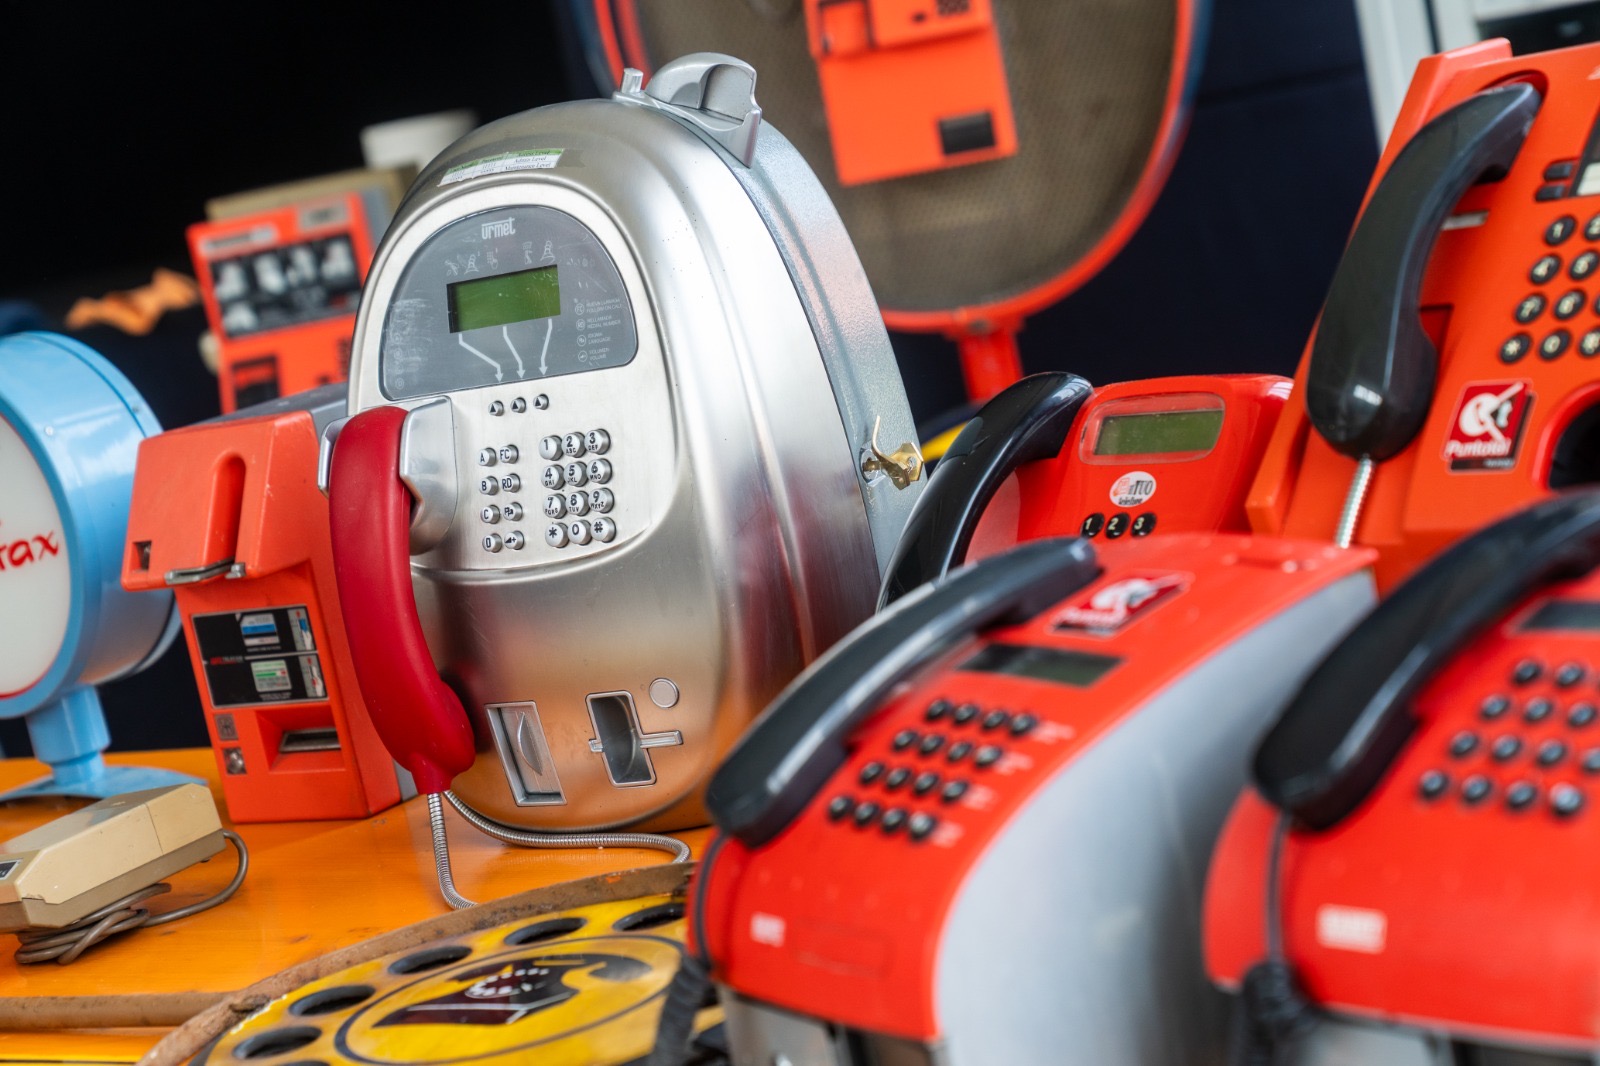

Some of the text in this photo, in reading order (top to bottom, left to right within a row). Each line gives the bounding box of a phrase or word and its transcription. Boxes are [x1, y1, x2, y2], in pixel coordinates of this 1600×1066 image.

[481, 217, 516, 240] urmet
[544, 432, 596, 450] 1 2 3
[480, 450, 510, 462] A FC
[545, 462, 598, 479] 4 5 6
[481, 478, 512, 491] B RD
[548, 491, 599, 508] 7 8 9
[483, 510, 489, 520] C
[572, 522, 603, 535] 0 #
[1085, 518, 1144, 530] 1 2 3
[486, 537, 491, 548] D
